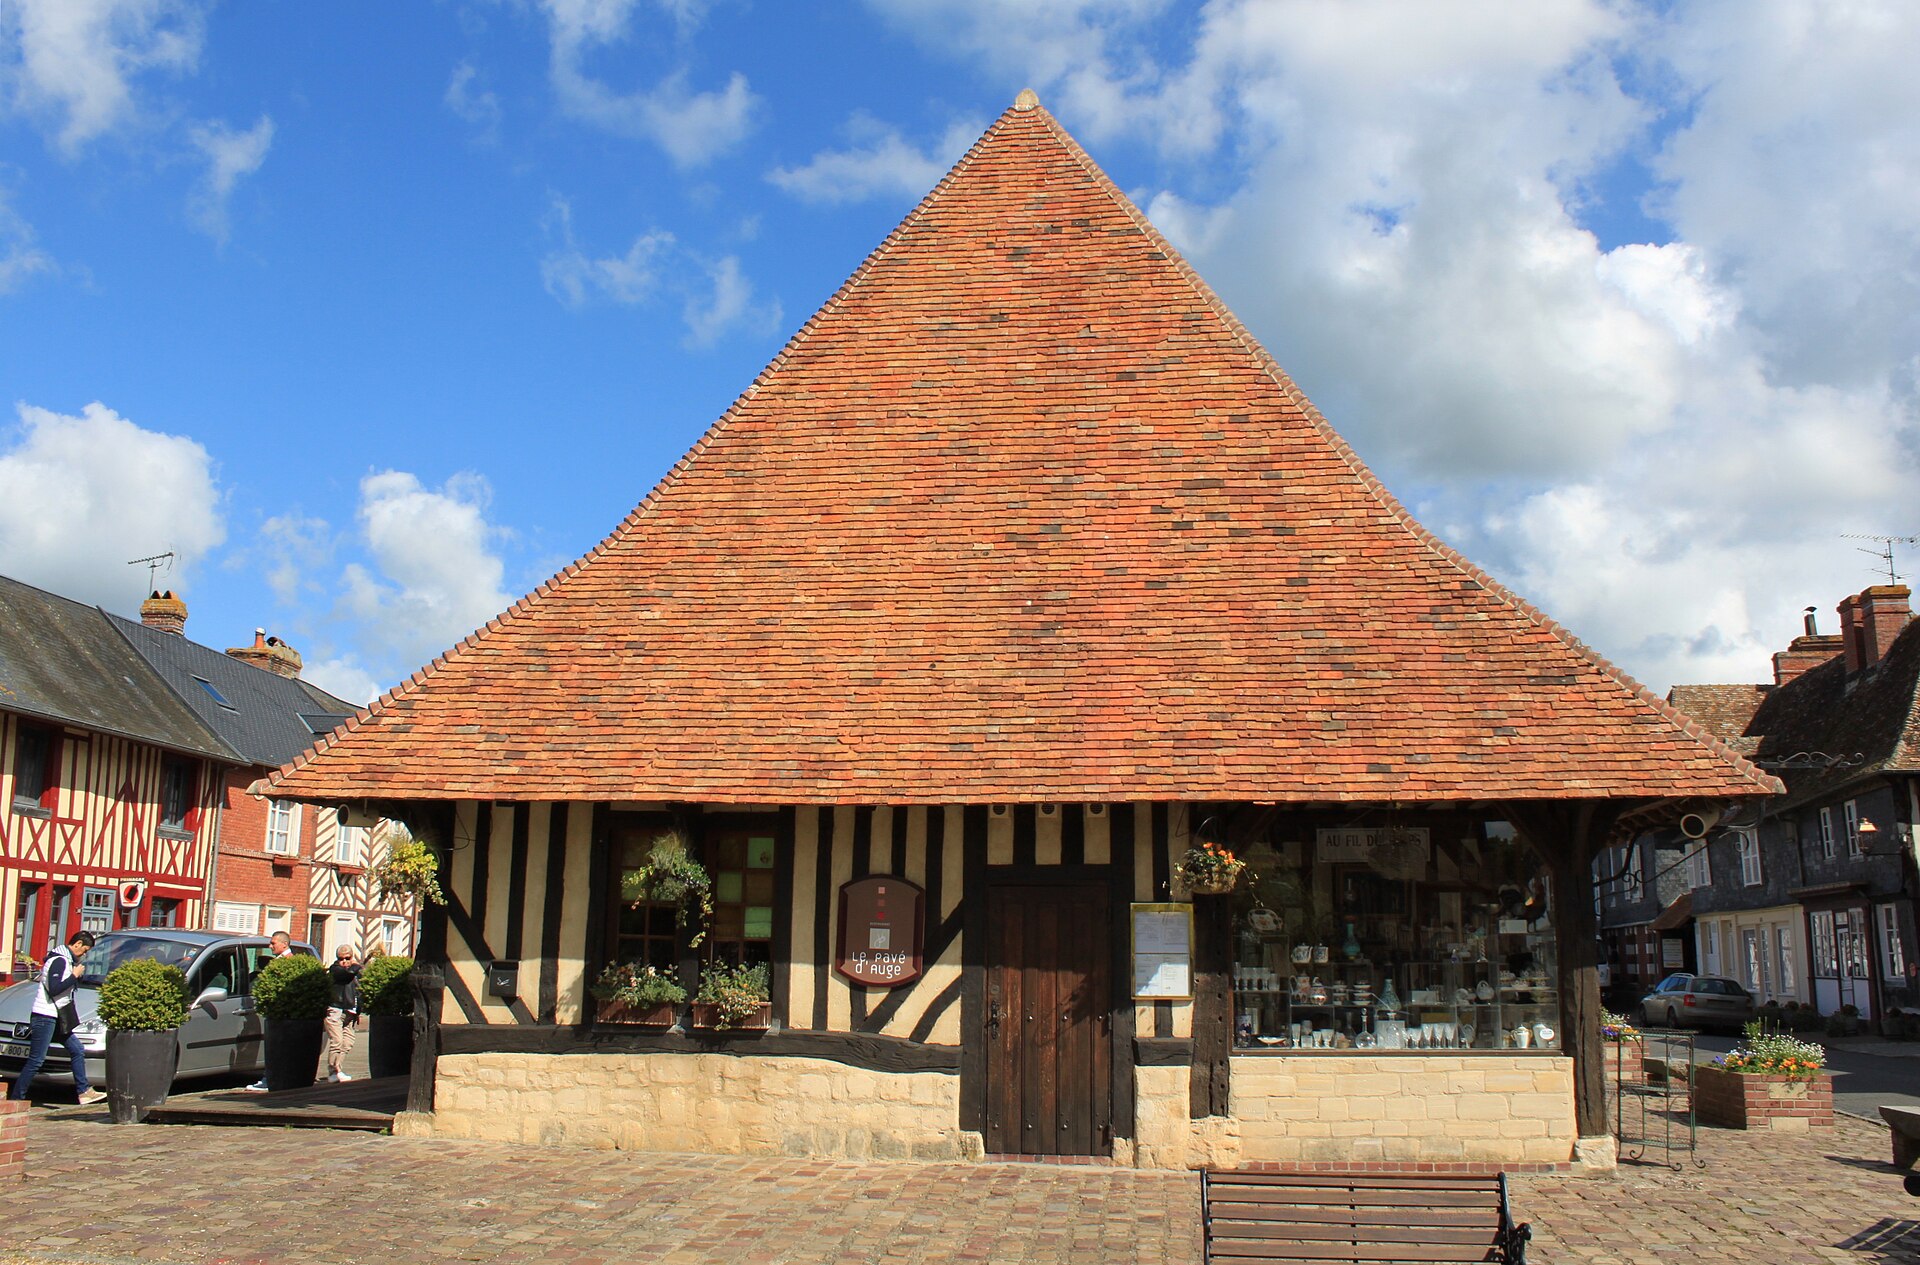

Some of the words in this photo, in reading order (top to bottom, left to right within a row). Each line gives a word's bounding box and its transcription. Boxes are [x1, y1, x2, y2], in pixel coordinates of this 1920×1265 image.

[1326, 835, 1340, 847] AU
[1346, 835, 1361, 847] FIL
[852, 951, 867, 962] Le
[855, 960, 902, 979] d'Auge
